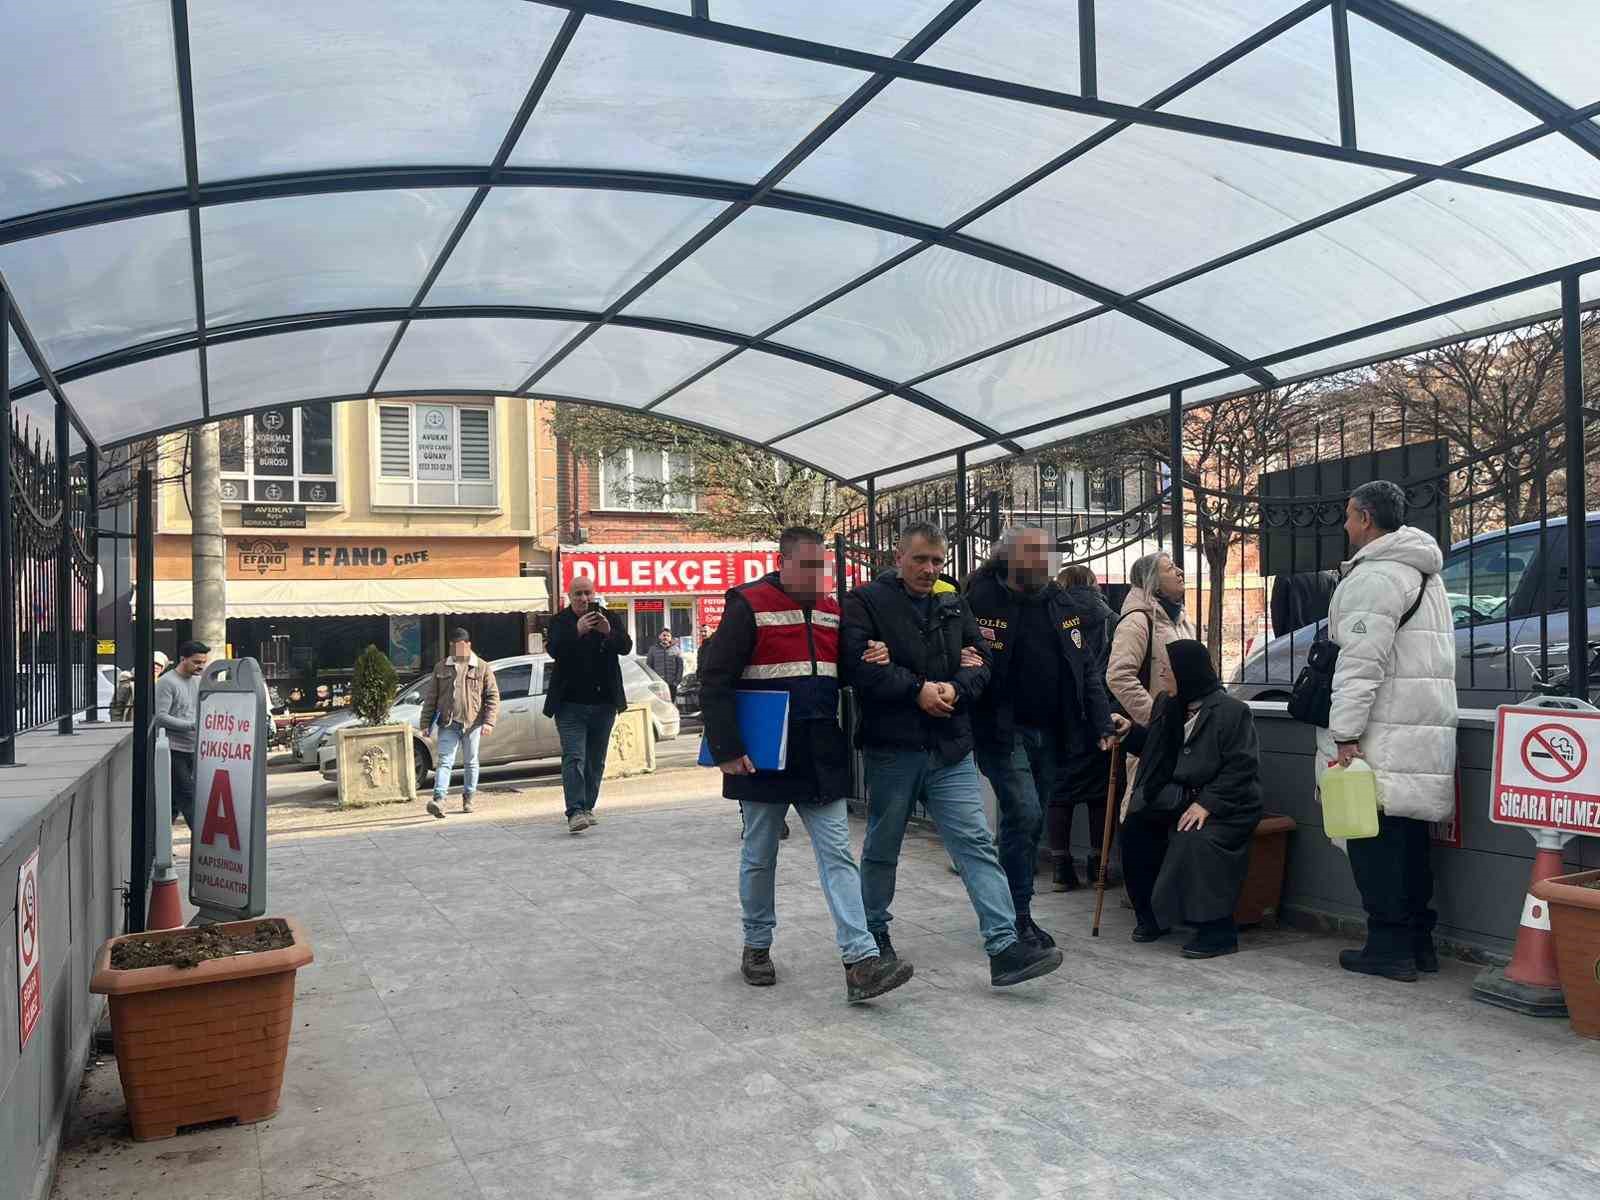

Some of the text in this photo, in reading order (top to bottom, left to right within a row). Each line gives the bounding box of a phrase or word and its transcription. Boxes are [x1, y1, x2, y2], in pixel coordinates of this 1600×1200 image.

[243, 556, 282, 565] EFANO
[302, 547, 429, 566] EFANO CAFE
[572, 555, 723, 589] DİLEKÇE
[205, 710, 250, 736] GİRİŞ ve
[200, 740, 252, 763] ÇIKIŞLAR
[200, 769, 241, 851] A
[1500, 788, 1547, 821] SİGARA
